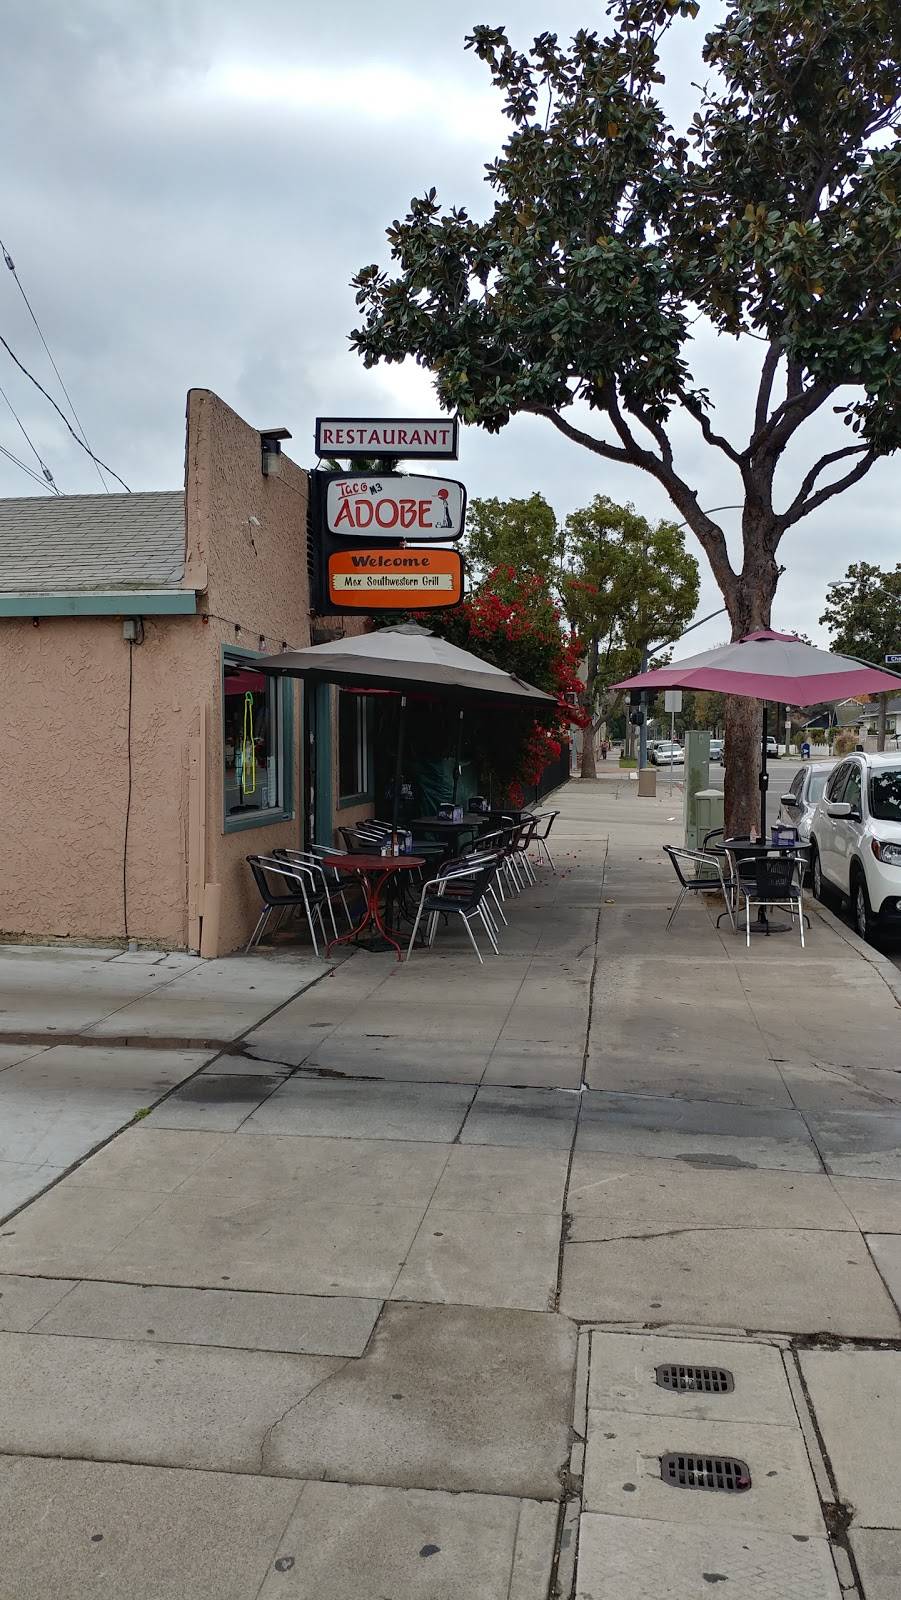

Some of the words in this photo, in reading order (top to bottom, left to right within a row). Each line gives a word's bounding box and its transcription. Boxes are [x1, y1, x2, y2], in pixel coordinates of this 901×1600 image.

[322, 429, 450, 445] RESTAURANT
[335, 482, 368, 498] Taco
[334, 498, 433, 528] ADOBE
[351, 555, 431, 567] Welcome
[344, 576, 362, 586] Mex
[366, 576, 419, 586] Southwestern
[422, 576, 439, 586] Grill
